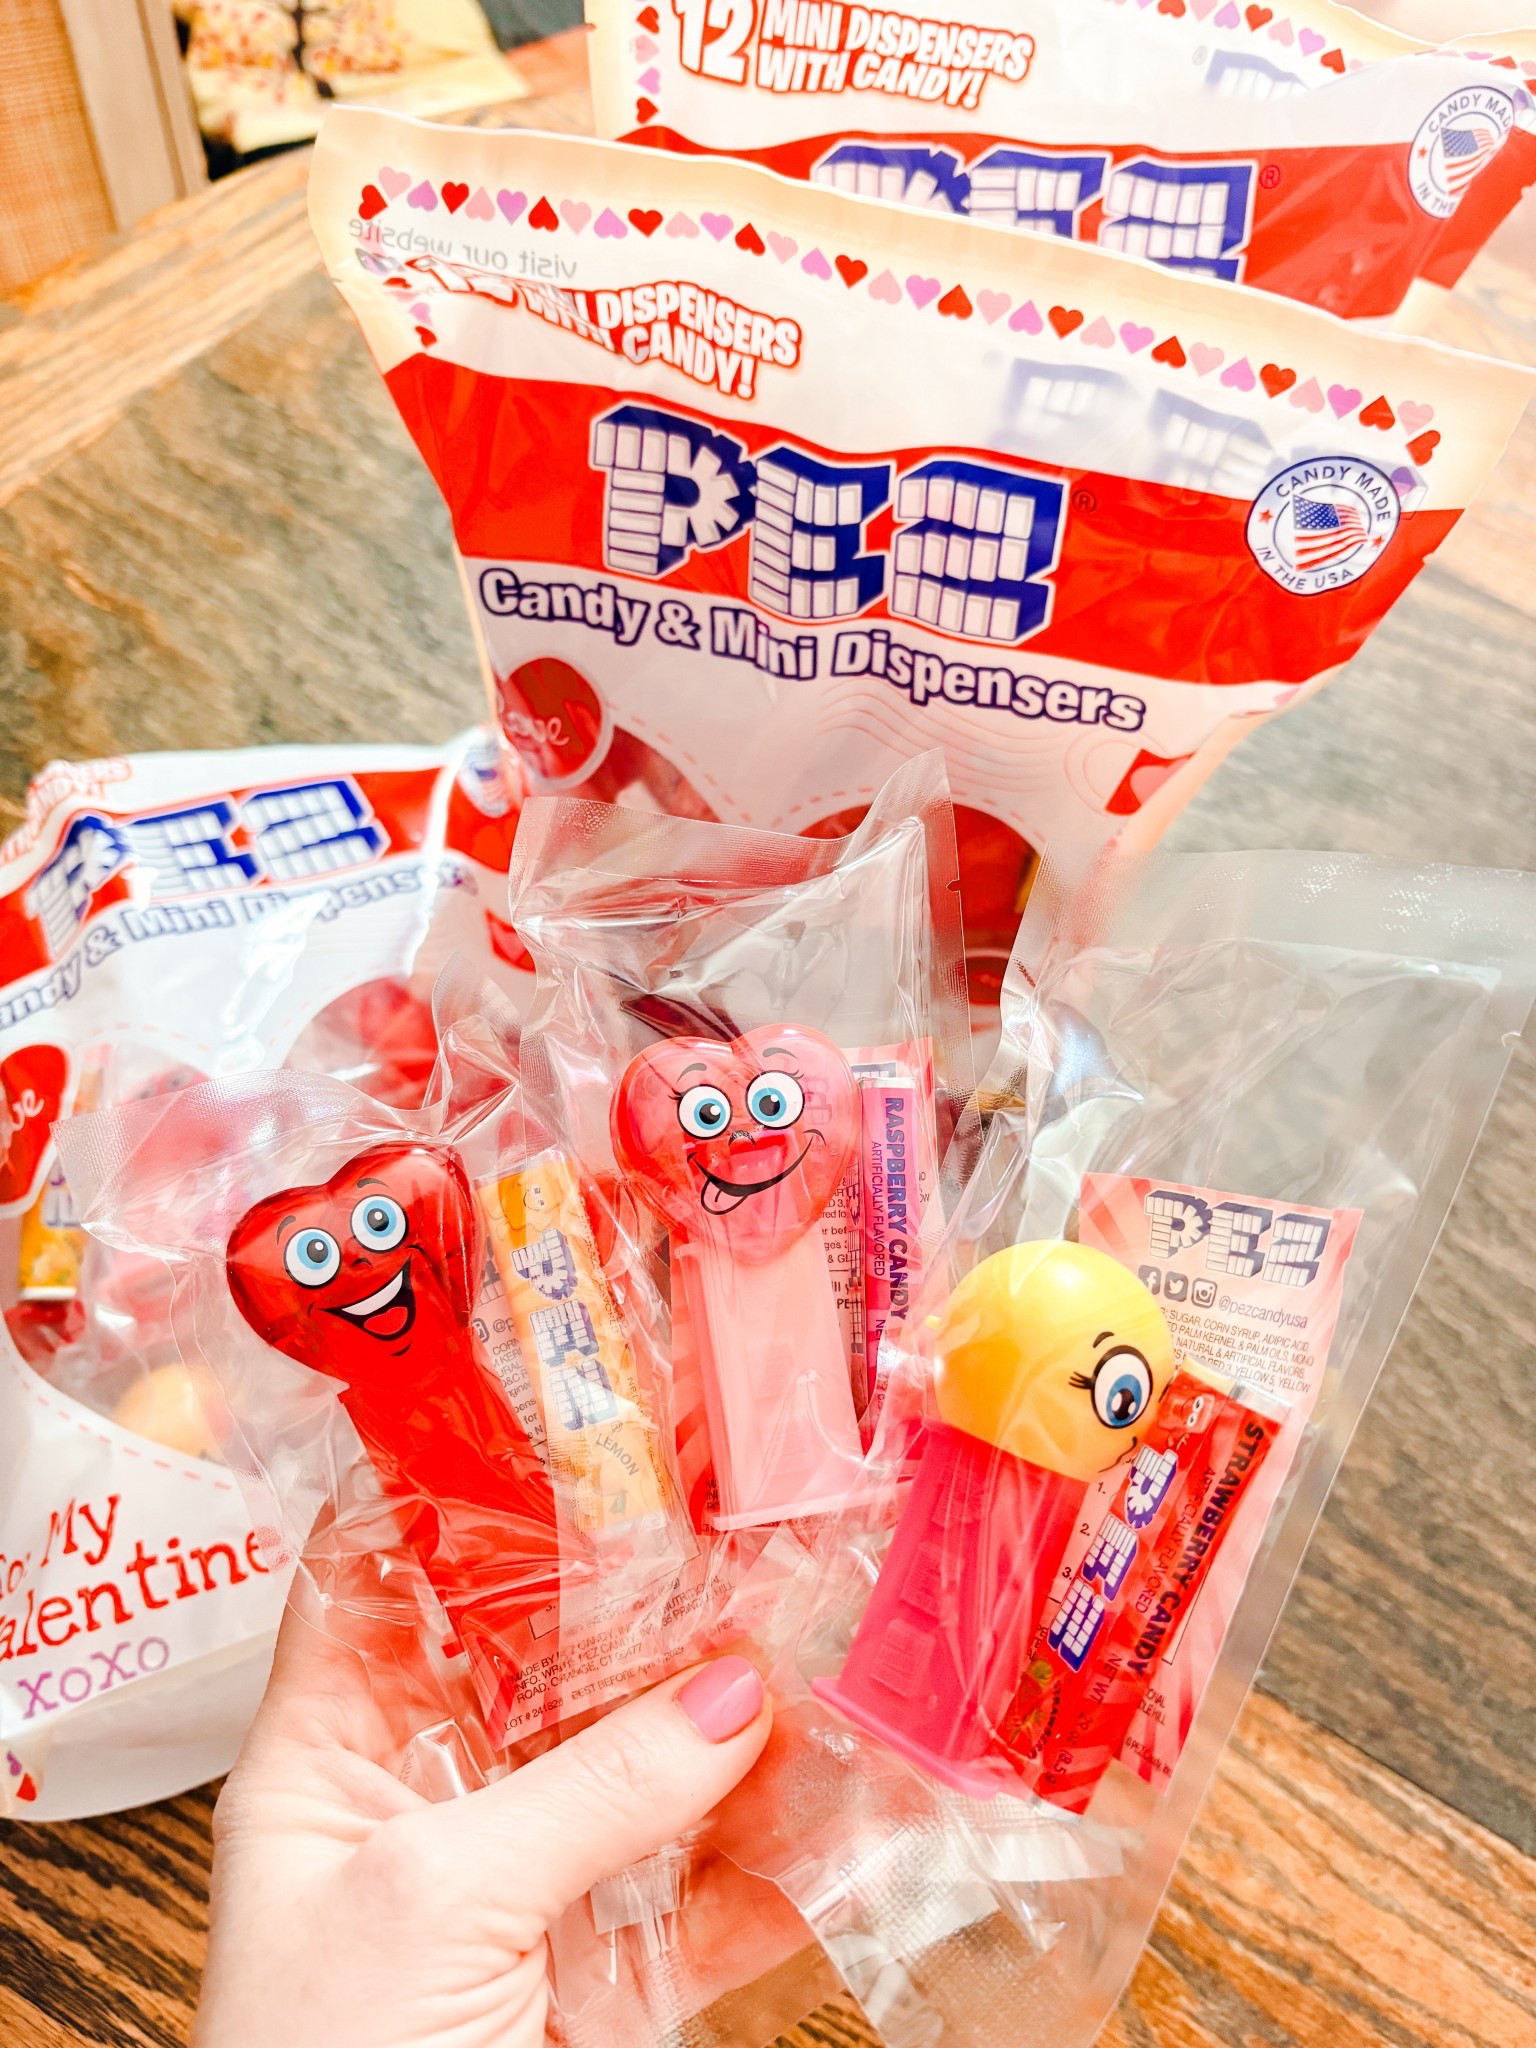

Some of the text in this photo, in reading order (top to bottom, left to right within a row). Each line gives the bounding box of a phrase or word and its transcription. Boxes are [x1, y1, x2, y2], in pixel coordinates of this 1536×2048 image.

[673, 0, 757, 85] 12
[760, 0, 1034, 81] MINI DISPENSERS
[756, 45, 988, 109] WITH CANDY!
[1428, 94, 1514, 134] CANDY MAD
[1416, 182, 1456, 214] IN THE
[598, 280, 803, 368] DISPENSERS
[620, 327, 758, 400] CANDY!
[590, 403, 1069, 646] PEZ
[1276, 465, 1391, 523] CANDY MADE
[1256, 546, 1354, 590] IN THE USA
[479, 568, 1146, 733] Candy & Mini Dispensers
[24, 773, 392, 969] PEZ
[0, 950, 82, 1032] andy
[83, 925, 124, 968] &
[119, 899, 236, 943] Mini
[870, 1140, 888, 1278] ARTIFICIALLY FLAVORED
[885, 1097, 910, 1322] RASPBERRY CANDY
[1144, 1189, 1333, 1288] PEZ
[511, 1227, 618, 1432] PEZ
[1203, 1318, 1230, 1335] CORN
[1231, 1325, 1261, 1344] SYRUP,
[1262, 1333, 1290, 1348] ADIPIC
[1218, 1295, 1309, 1330] @pezcandyusa
[1176, 1336, 1214, 1357] NATURAL
[1216, 1347, 1222, 1358] &
[1224, 1351, 1266, 1370] ARTIFICIAL
[1179, 1324, 1202, 1340] PALM
[1203, 1331, 1236, 1349] KERNEL
[1239, 1340, 1244, 1350] &
[1246, 1342, 1269, 1357] PALM
[1269, 1347, 1290, 1362] OILS,
[1291, 1353, 1314, 1368] MONO
[1235, 1366, 1268, 1384] YELLOW
[1278, 1378, 1312, 1394] YELLOW
[595, 1432, 641, 1477] LEMON
[1098, 1481, 1106, 1495] 1.
[41, 1493, 121, 1569] My
[1047, 1443, 1179, 1674] PEZ
[1079, 1522, 1090, 1537] 2.
[1126, 1421, 1265, 1677] STRAWBERRY CANDY
[1061, 1566, 1073, 1581] 3.
[511, 1661, 540, 1682] MADE
[541, 1653, 555, 1669] BY
[514, 1675, 541, 1693] INFO.
[516, 1681, 550, 1704] ROAD,
[600, 1654, 613, 1668] CT
[1104, 1652, 1122, 1683] NET
[504, 1714, 524, 1731] LOT
[571, 1683, 596, 1701] BEST
[598, 1667, 635, 1691] BEFORE
